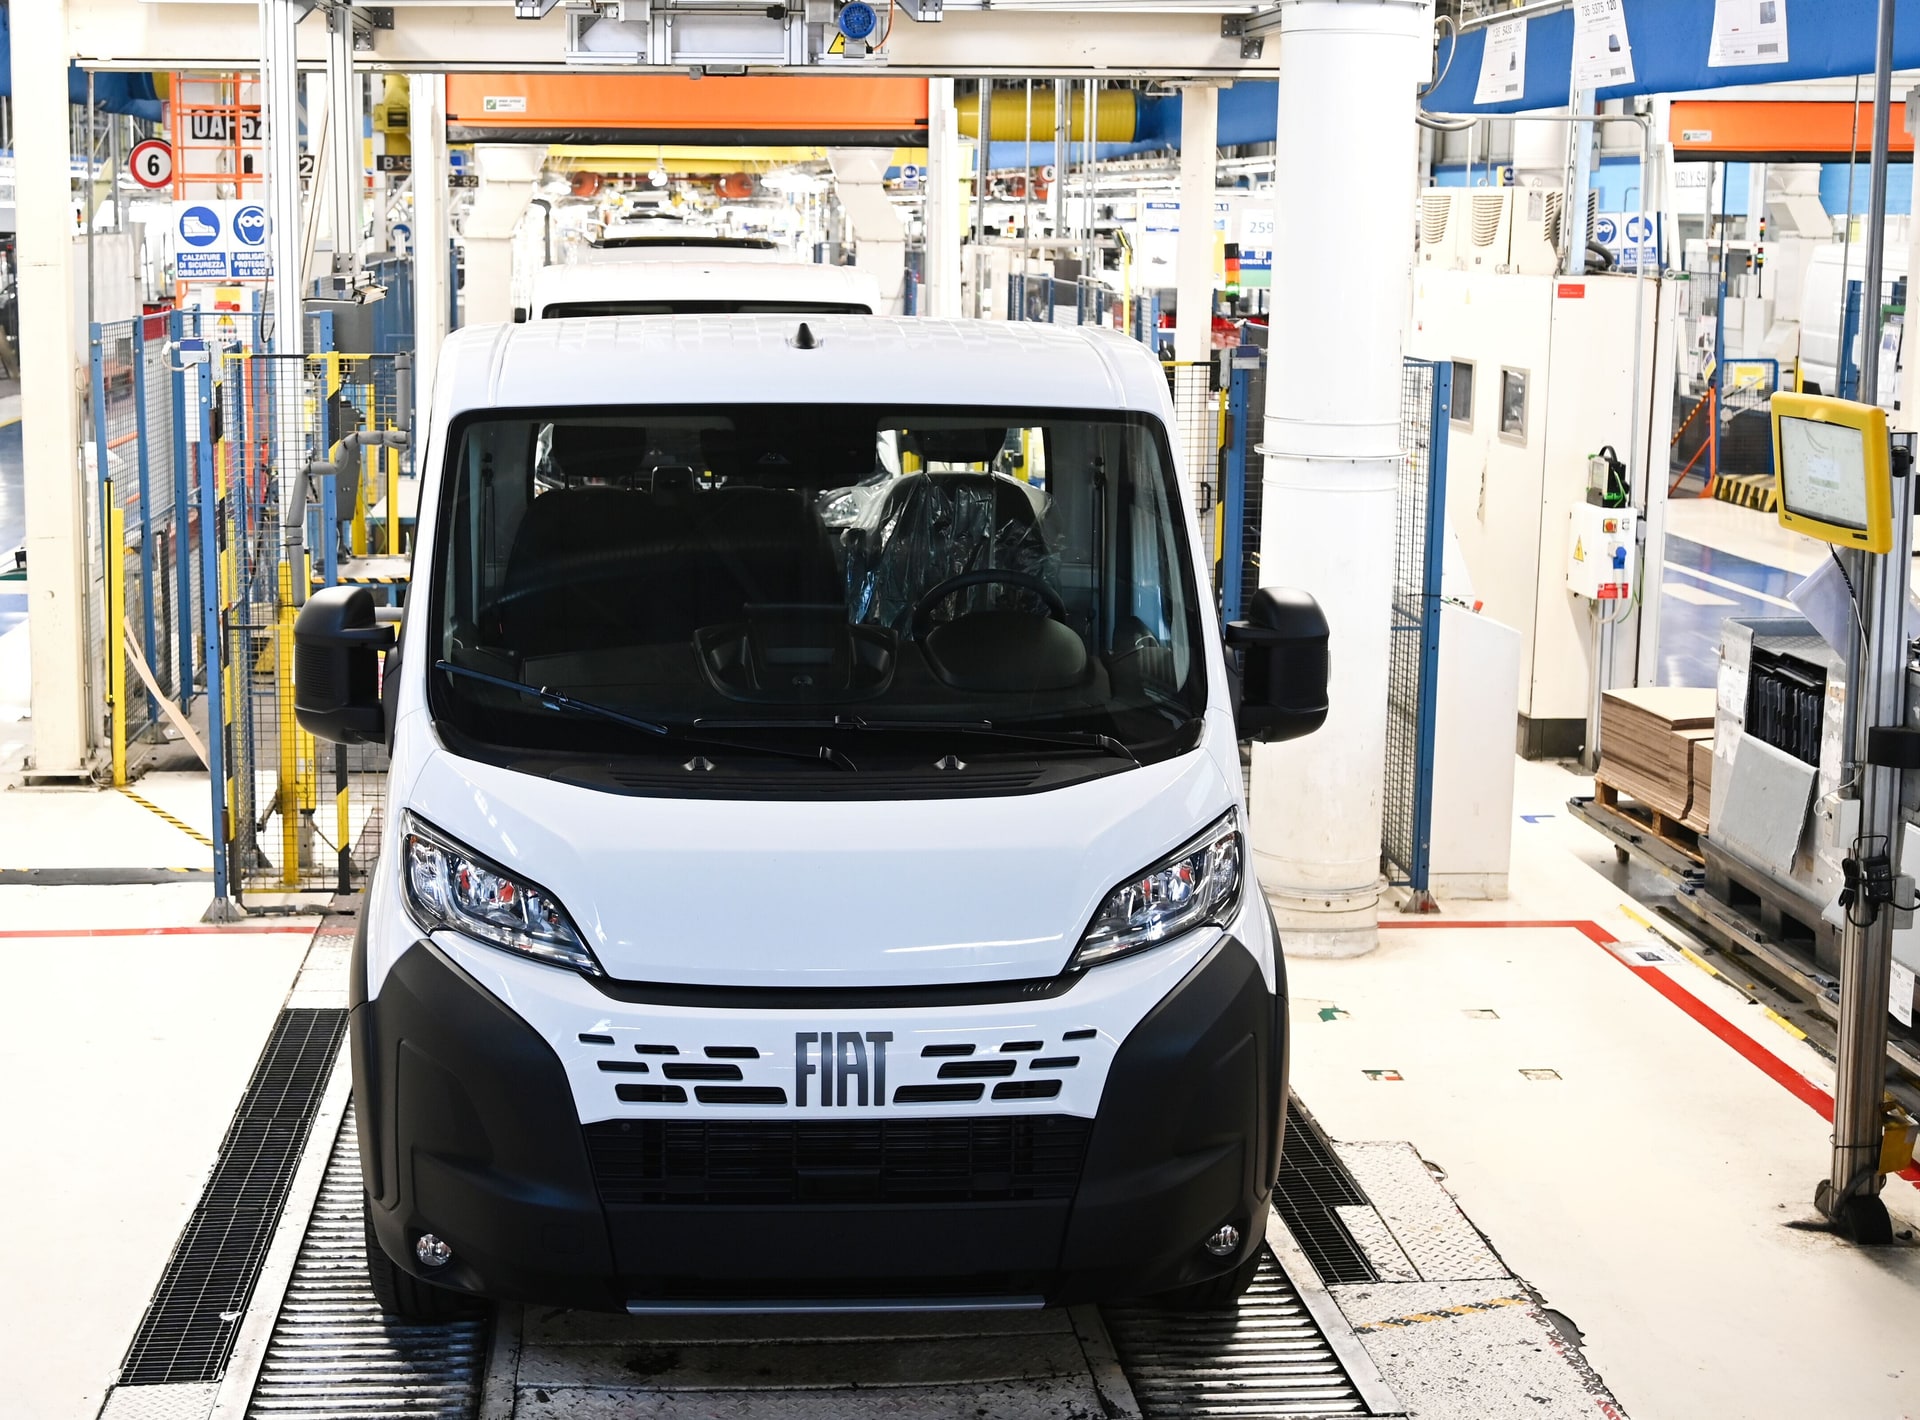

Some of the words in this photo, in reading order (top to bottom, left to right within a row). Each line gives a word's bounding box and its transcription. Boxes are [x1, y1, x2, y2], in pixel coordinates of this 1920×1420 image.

[147, 154, 160, 176] 6
[299, 157, 313, 176] 2
[1249, 221, 1274, 233] 259
[182, 253, 220, 261] CALZATURE
[178, 268, 226, 276] OBBLIGATORIE
[796, 1031, 893, 1107] FIAT
